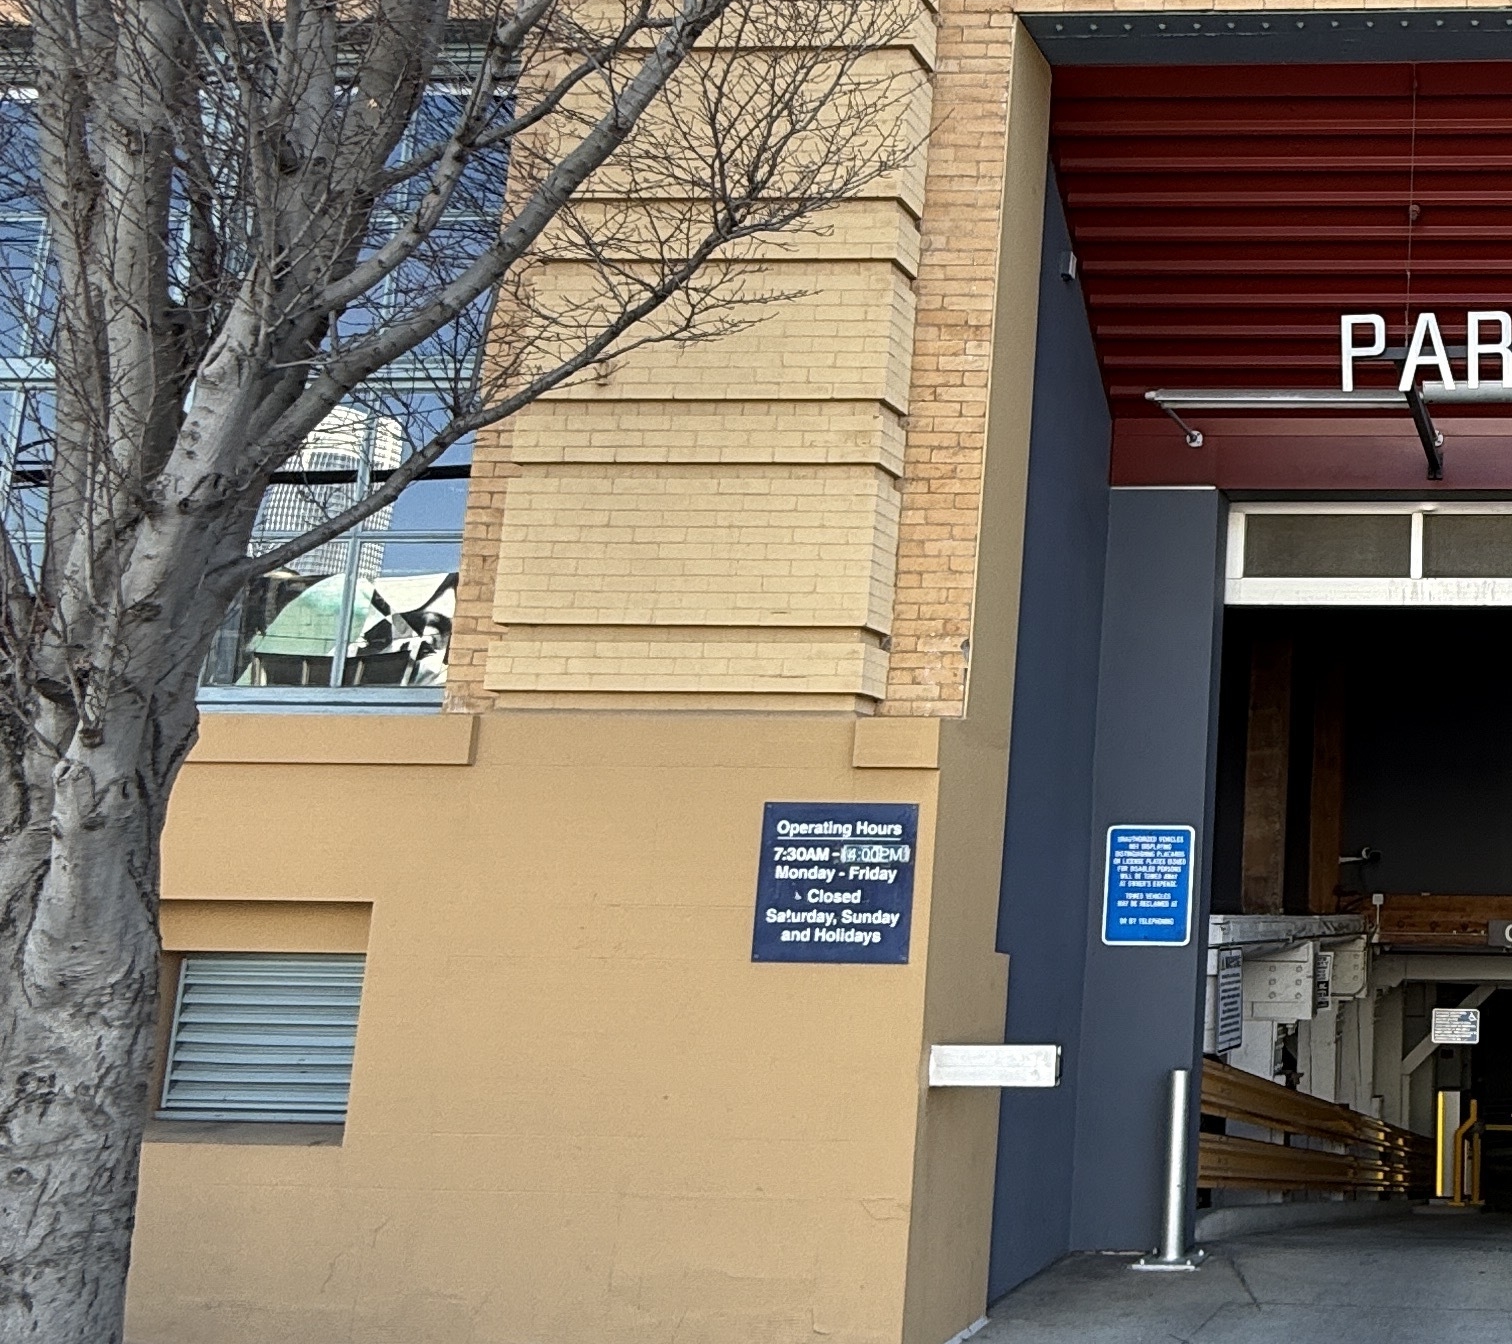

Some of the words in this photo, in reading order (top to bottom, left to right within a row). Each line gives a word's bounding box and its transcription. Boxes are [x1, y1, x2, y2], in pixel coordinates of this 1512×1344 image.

[777, 820, 852, 838] Operating
[856, 821, 902, 835] Hours
[773, 847, 830, 861] 7:30AM
[775, 865, 836, 883] Monday
[848, 866, 898, 884] Friday
[807, 888, 862, 903] Closed
[841, 909, 900, 928] Sunday
[780, 927, 811, 942] and
[813, 927, 882, 946] Holidays
